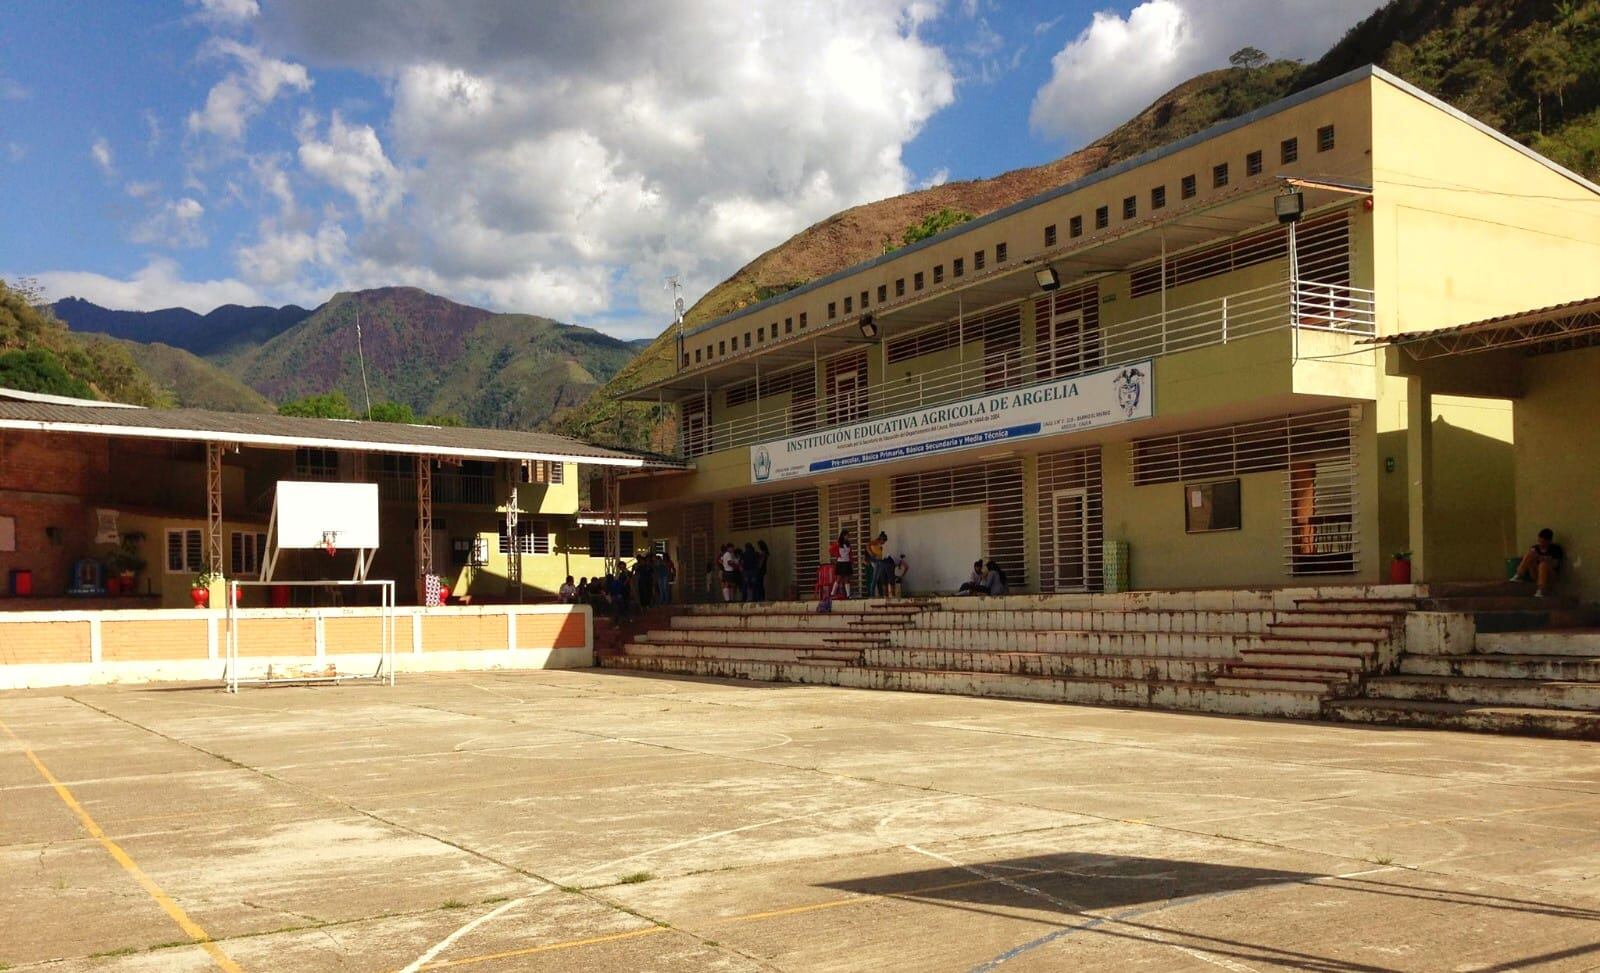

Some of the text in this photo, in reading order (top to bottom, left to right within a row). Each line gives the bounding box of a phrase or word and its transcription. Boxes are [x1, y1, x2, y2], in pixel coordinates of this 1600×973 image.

[787, 383, 1079, 452] INSTITUCIÓN EDUCATIVA AGRICOLA DE ARGELIA
[925, 438, 958, 451] Secundaria
[964, 434, 983, 444] Media
[984, 429, 1009, 440] Técnica
